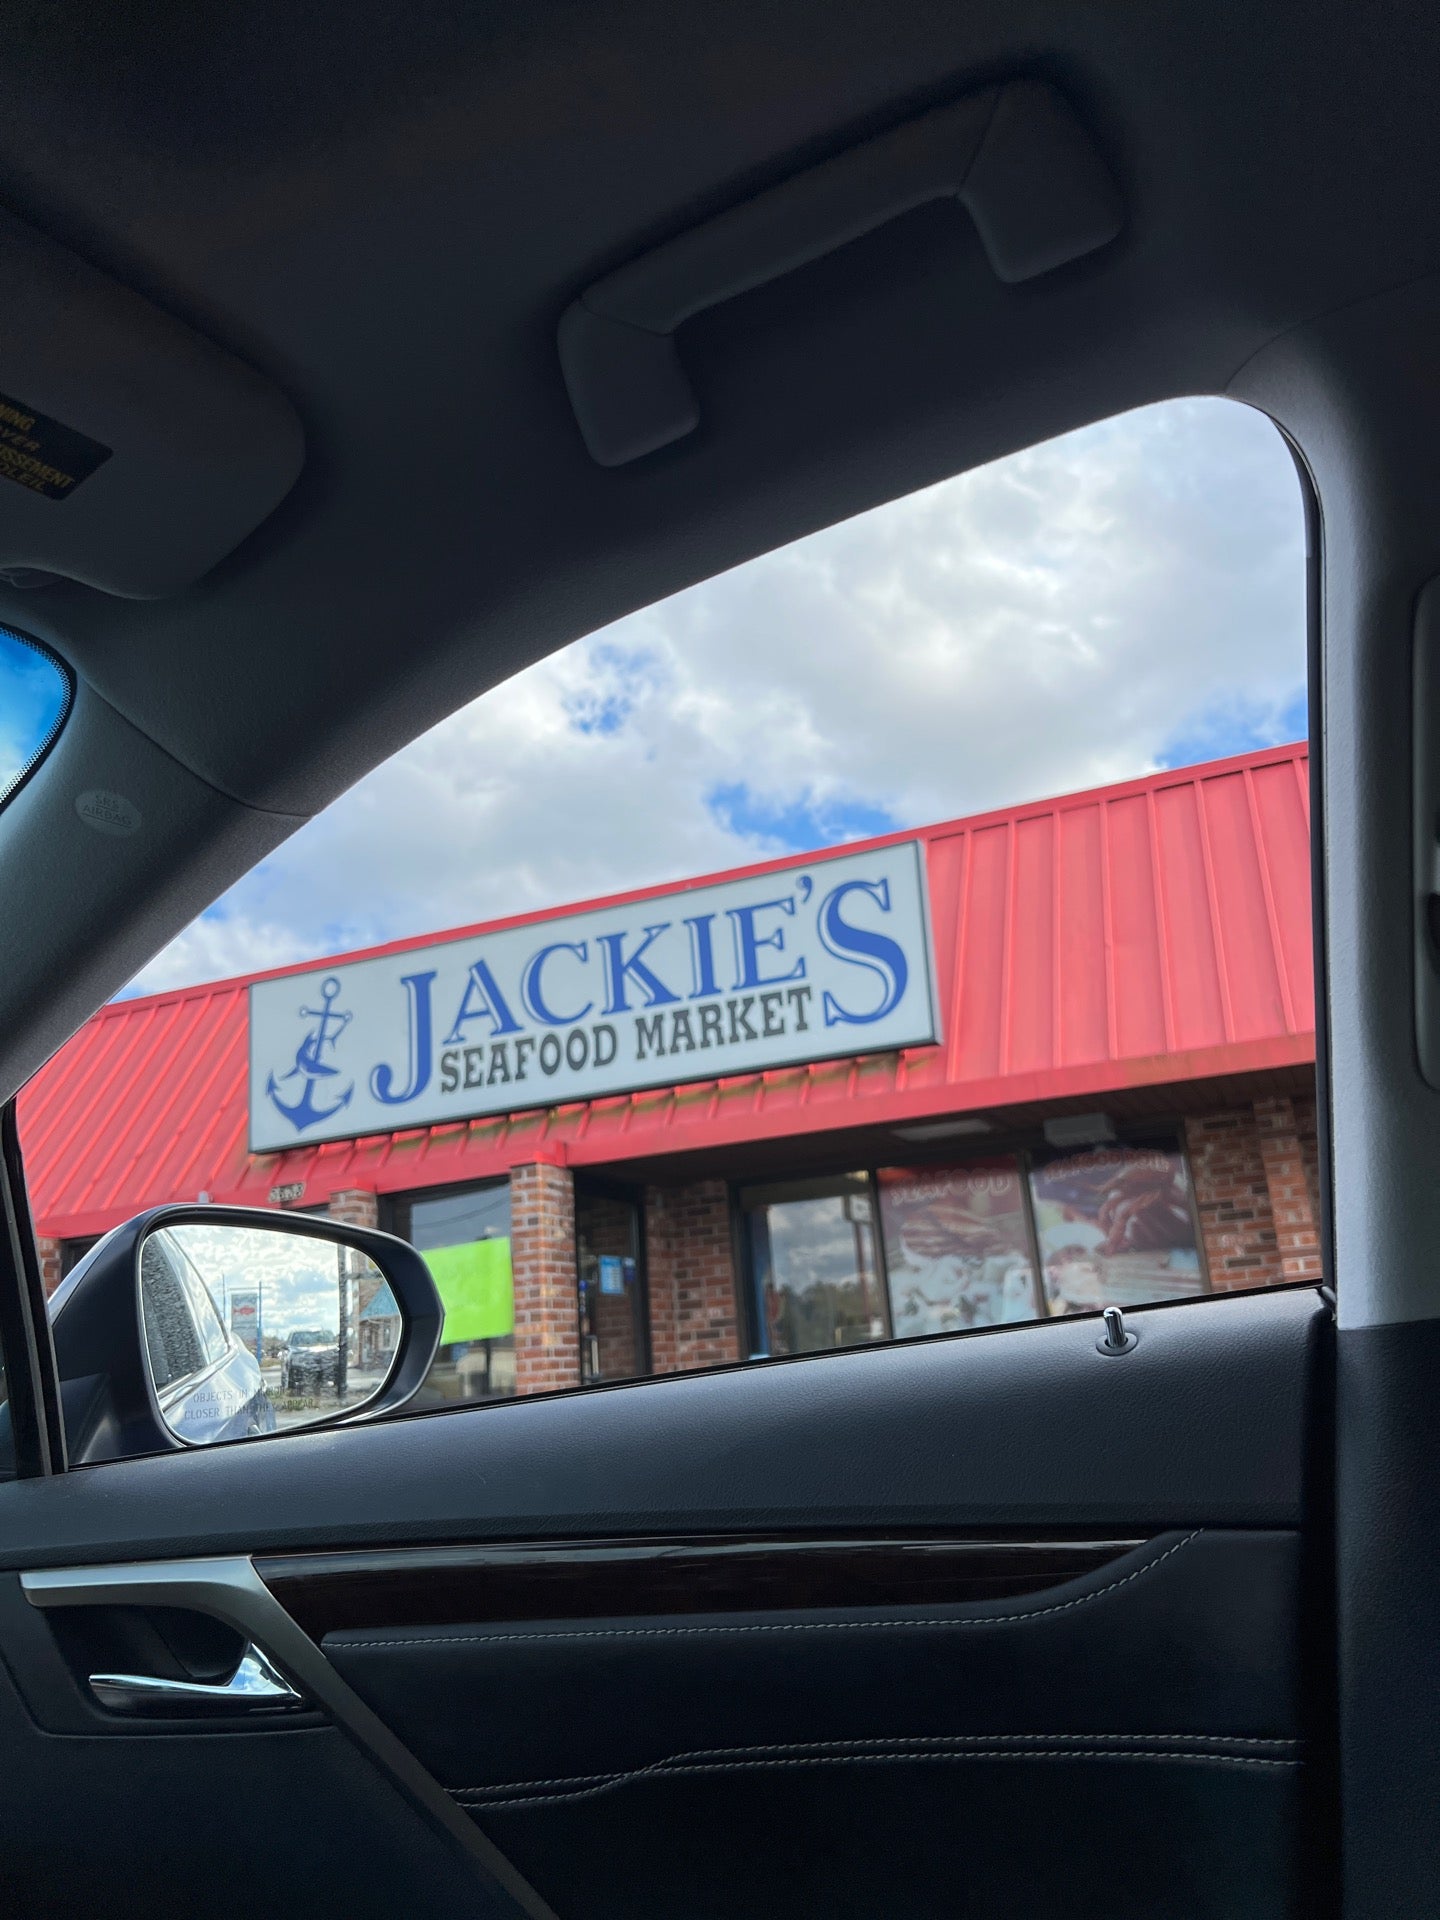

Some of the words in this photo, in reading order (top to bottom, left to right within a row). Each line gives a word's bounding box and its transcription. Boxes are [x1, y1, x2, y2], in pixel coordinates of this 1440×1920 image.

[82, 804, 132, 826] AIRBAG
[369, 876, 910, 1105] JACKIE'S
[440, 1024, 618, 1094] SEAFOOD
[635, 986, 812, 1060] MARKET
[193, 1390, 233, 1403] OBJECTS
[184, 1407, 220, 1420] CLOSER
